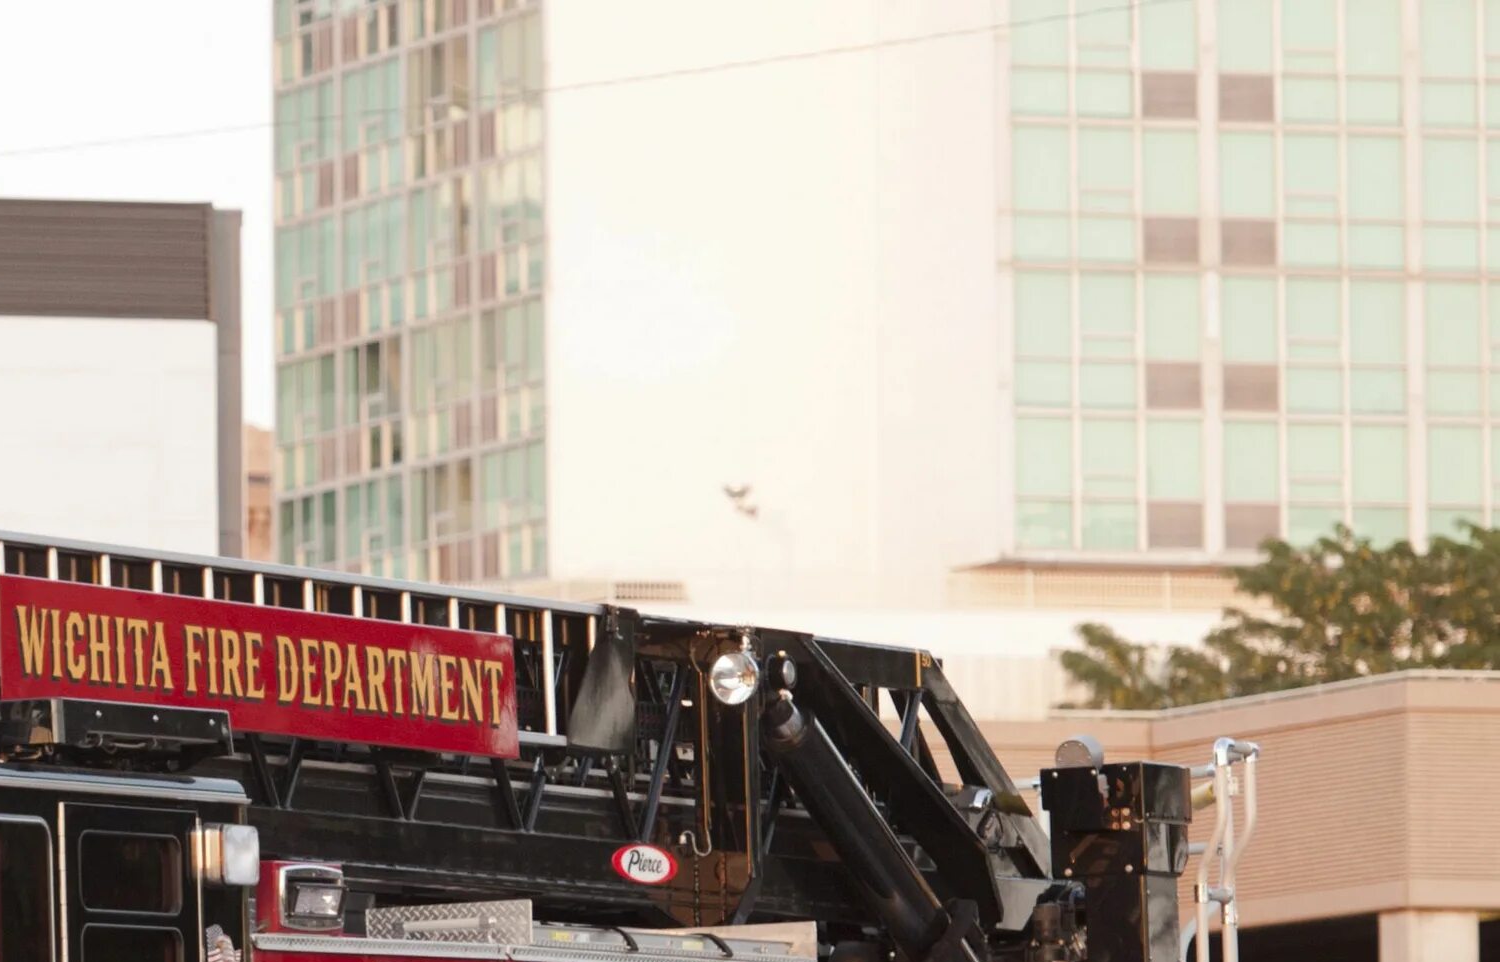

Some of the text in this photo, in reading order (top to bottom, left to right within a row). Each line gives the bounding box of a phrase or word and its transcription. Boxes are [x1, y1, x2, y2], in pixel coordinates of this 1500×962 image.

[15, 605, 505, 728] WICHITA FIRE DEPARTMENT
[627, 849, 663, 874] Pierce
